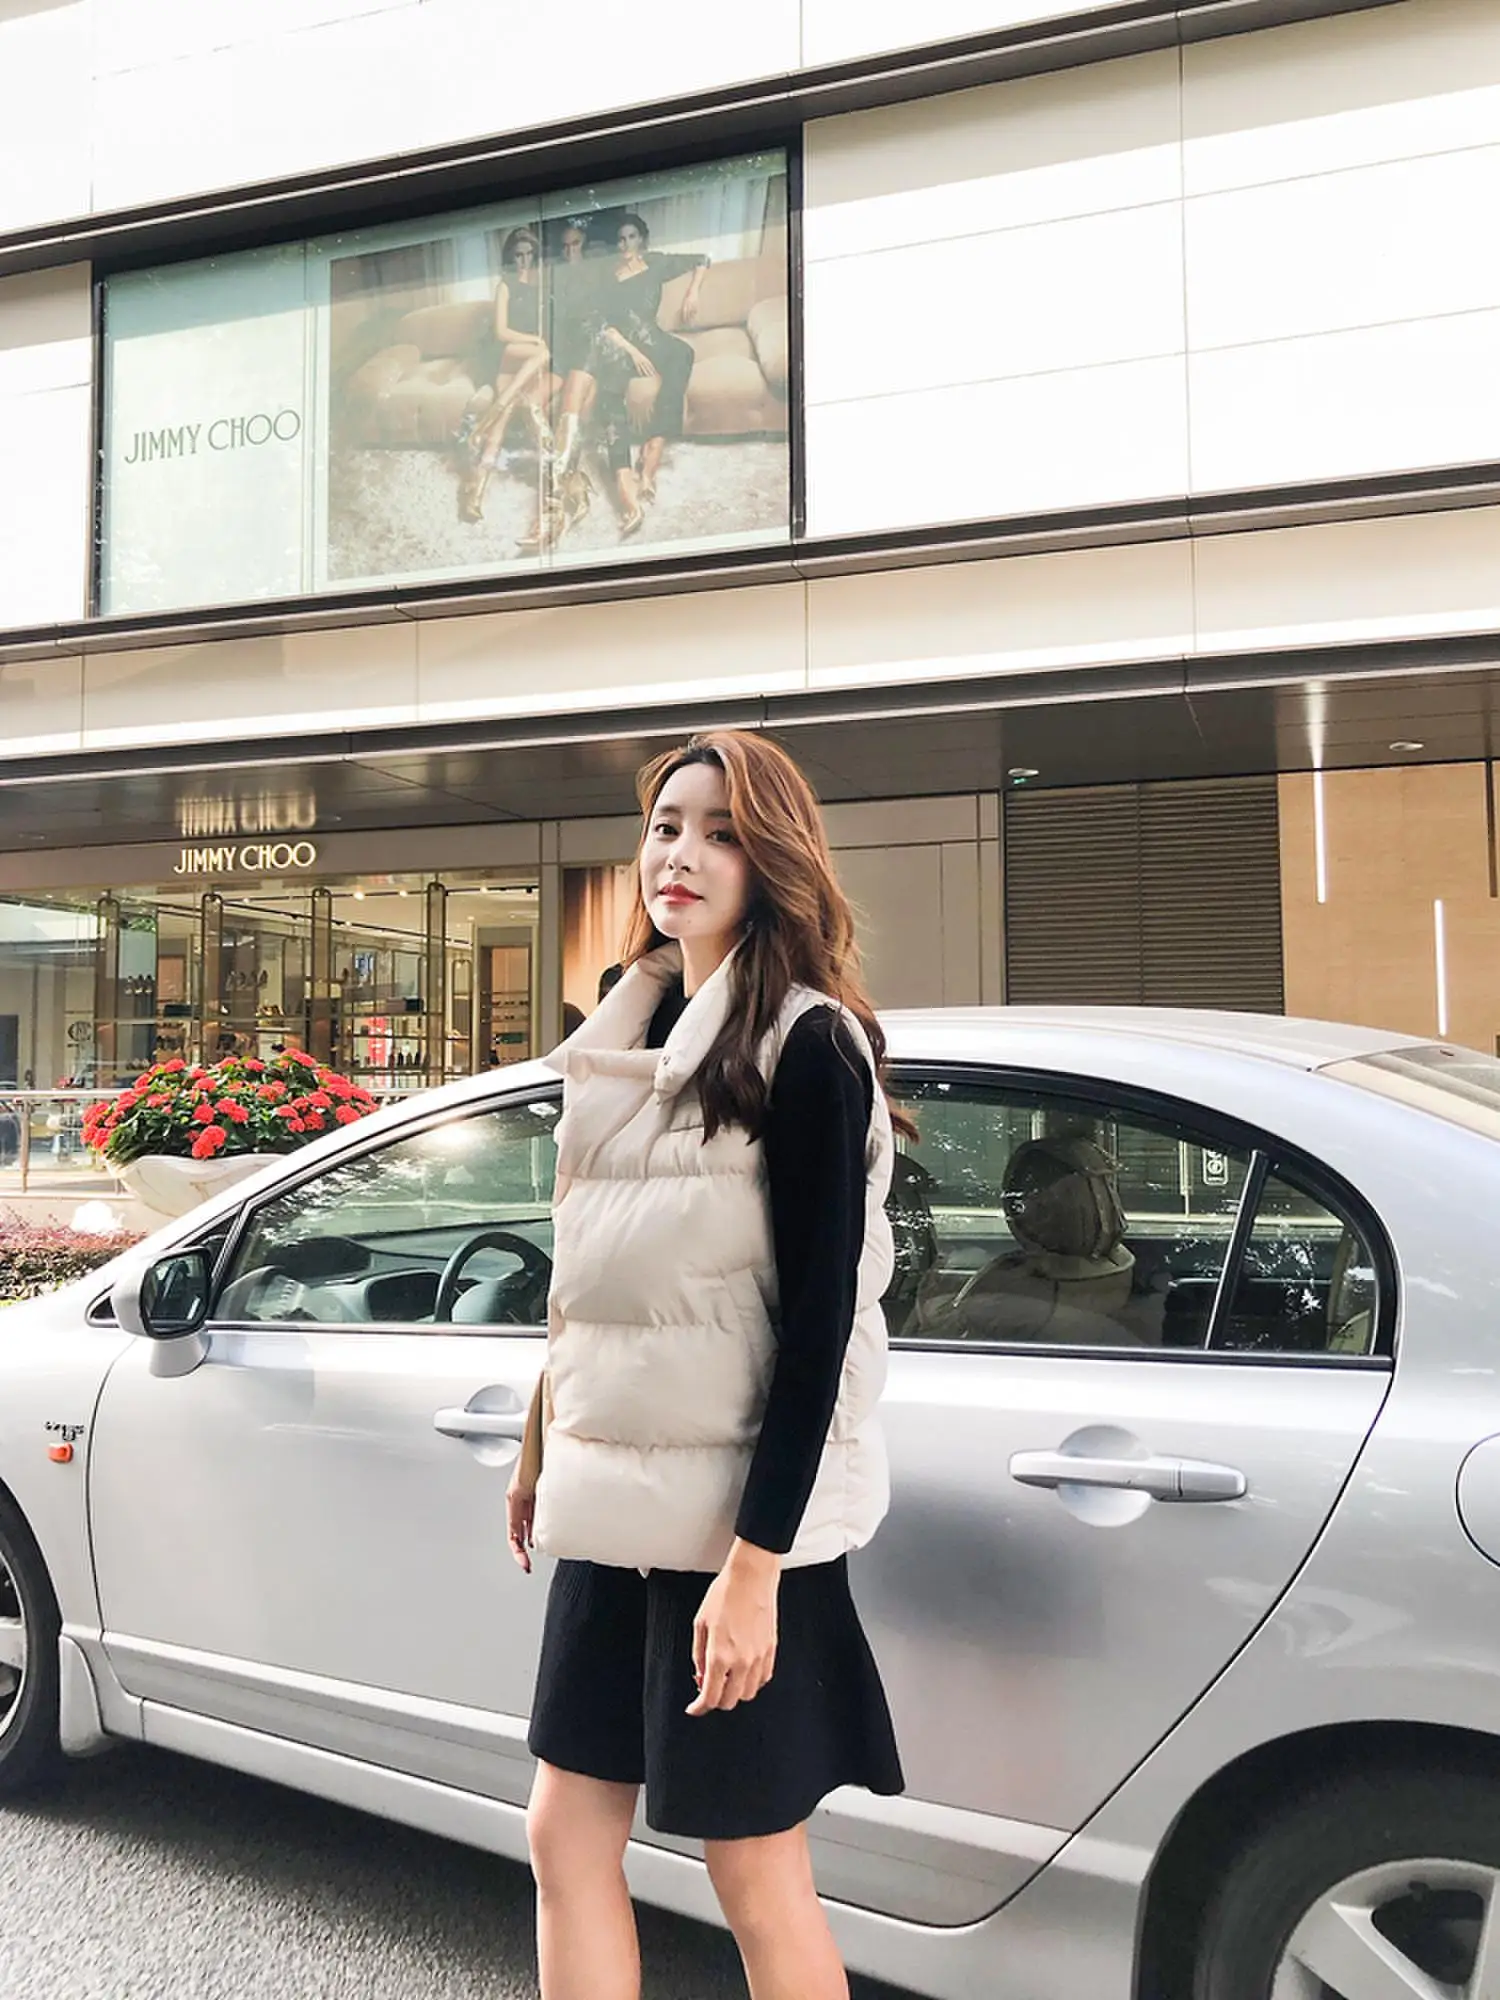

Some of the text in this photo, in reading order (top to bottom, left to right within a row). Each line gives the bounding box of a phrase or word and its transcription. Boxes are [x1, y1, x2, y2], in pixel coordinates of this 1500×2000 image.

[124, 409, 301, 464] JIMMY CHOO
[173, 842, 316, 874] JIMMY CHOO
